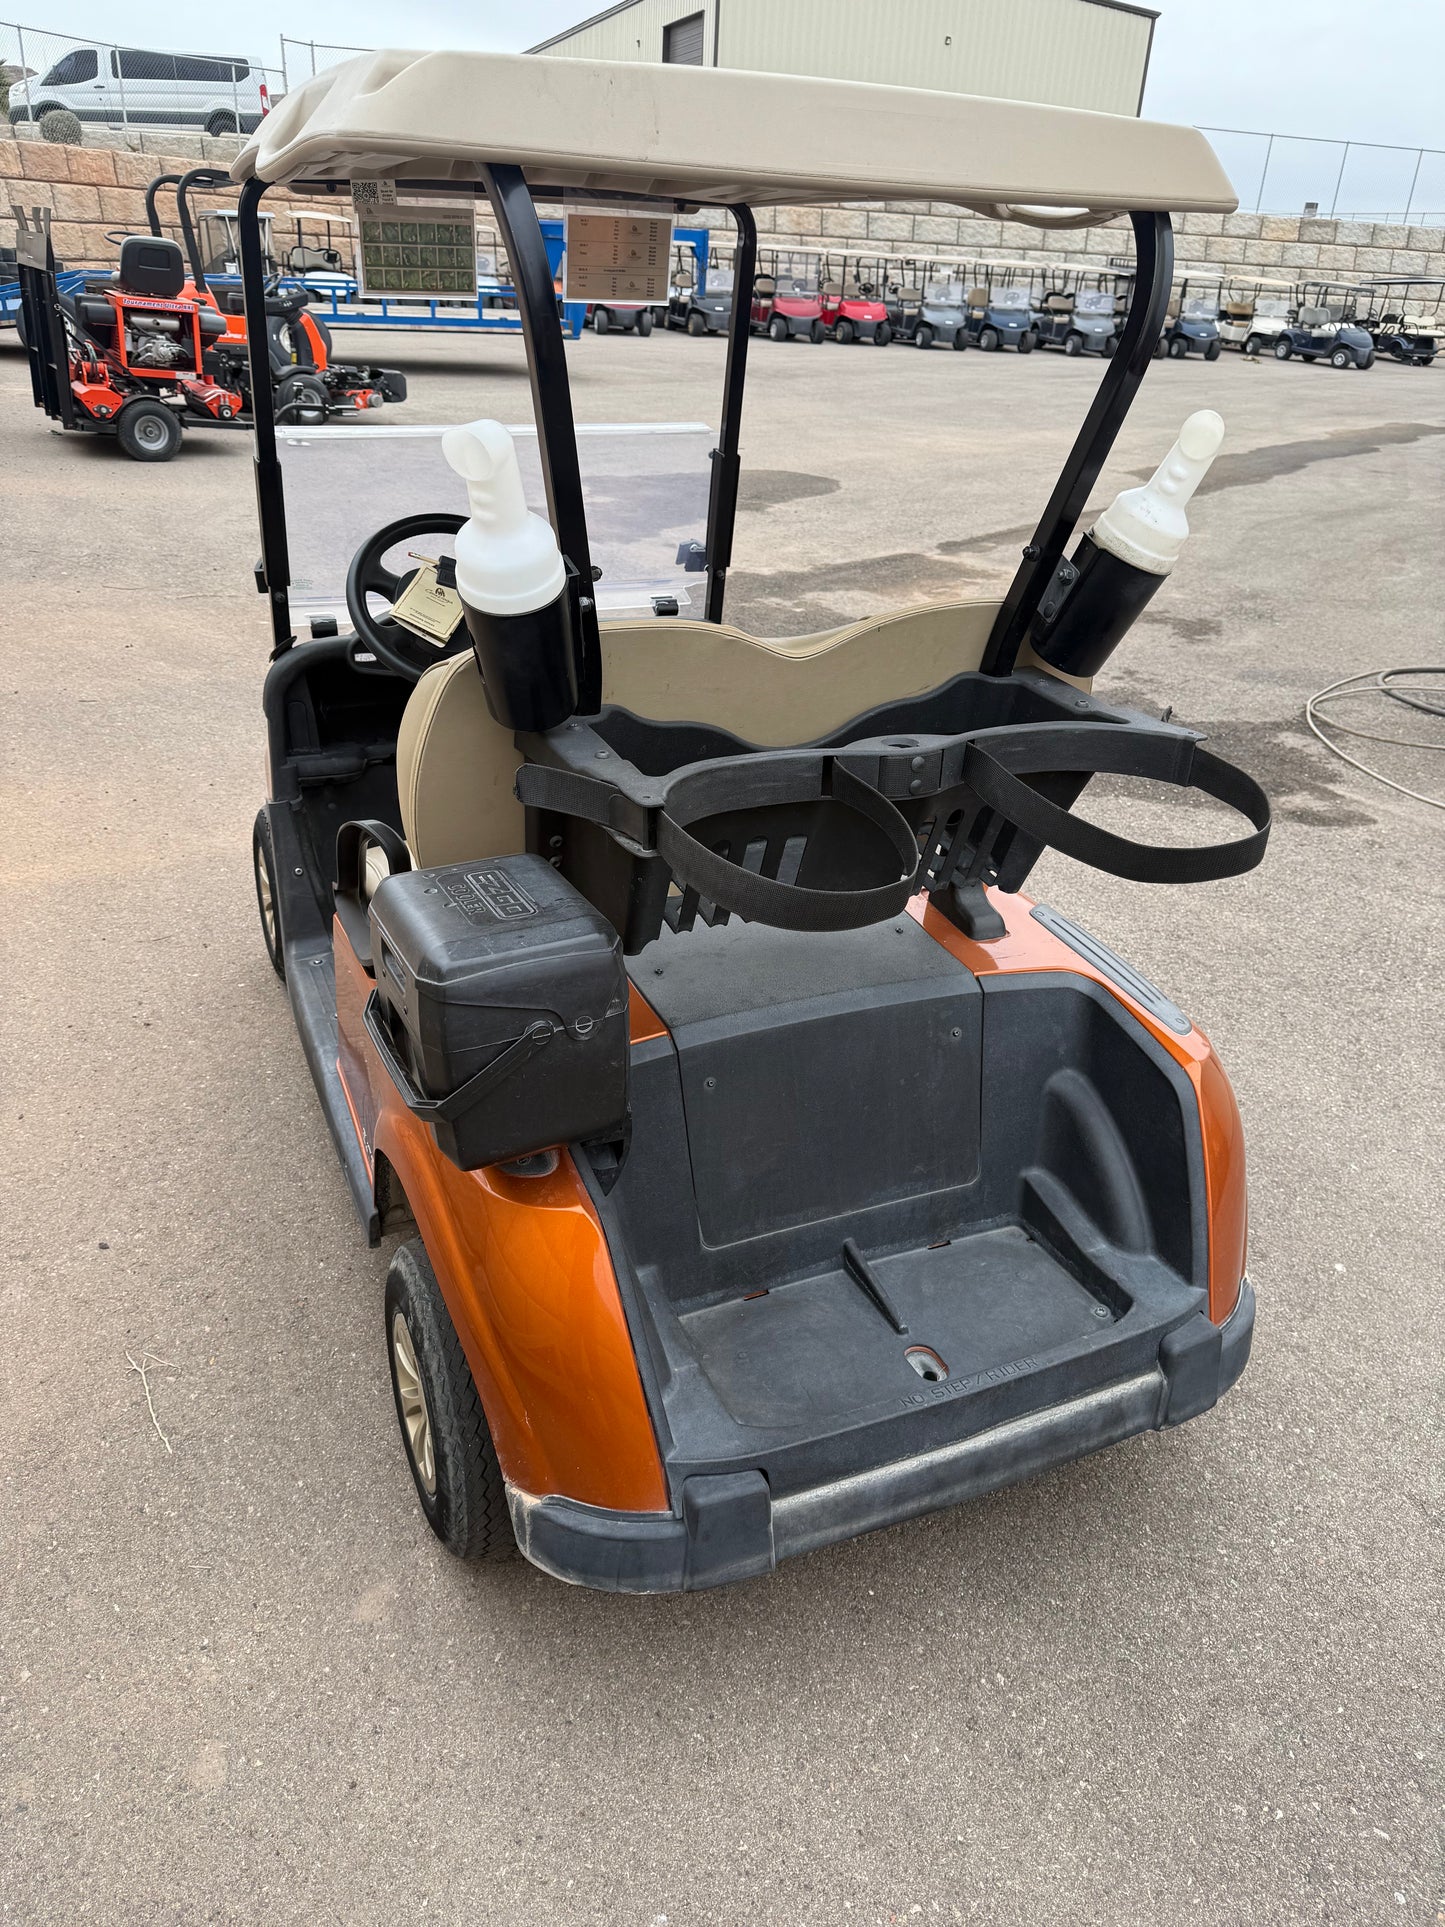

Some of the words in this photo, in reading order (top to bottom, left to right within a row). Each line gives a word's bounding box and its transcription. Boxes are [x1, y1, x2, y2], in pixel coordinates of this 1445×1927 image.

[124, 298, 163, 308] Tournament
[448, 884, 486, 916] COOLER
[900, 1394, 925, 1408] NO
[930, 1378, 970, 1398] STEP
[986, 1358, 1038, 1381] RIDER
